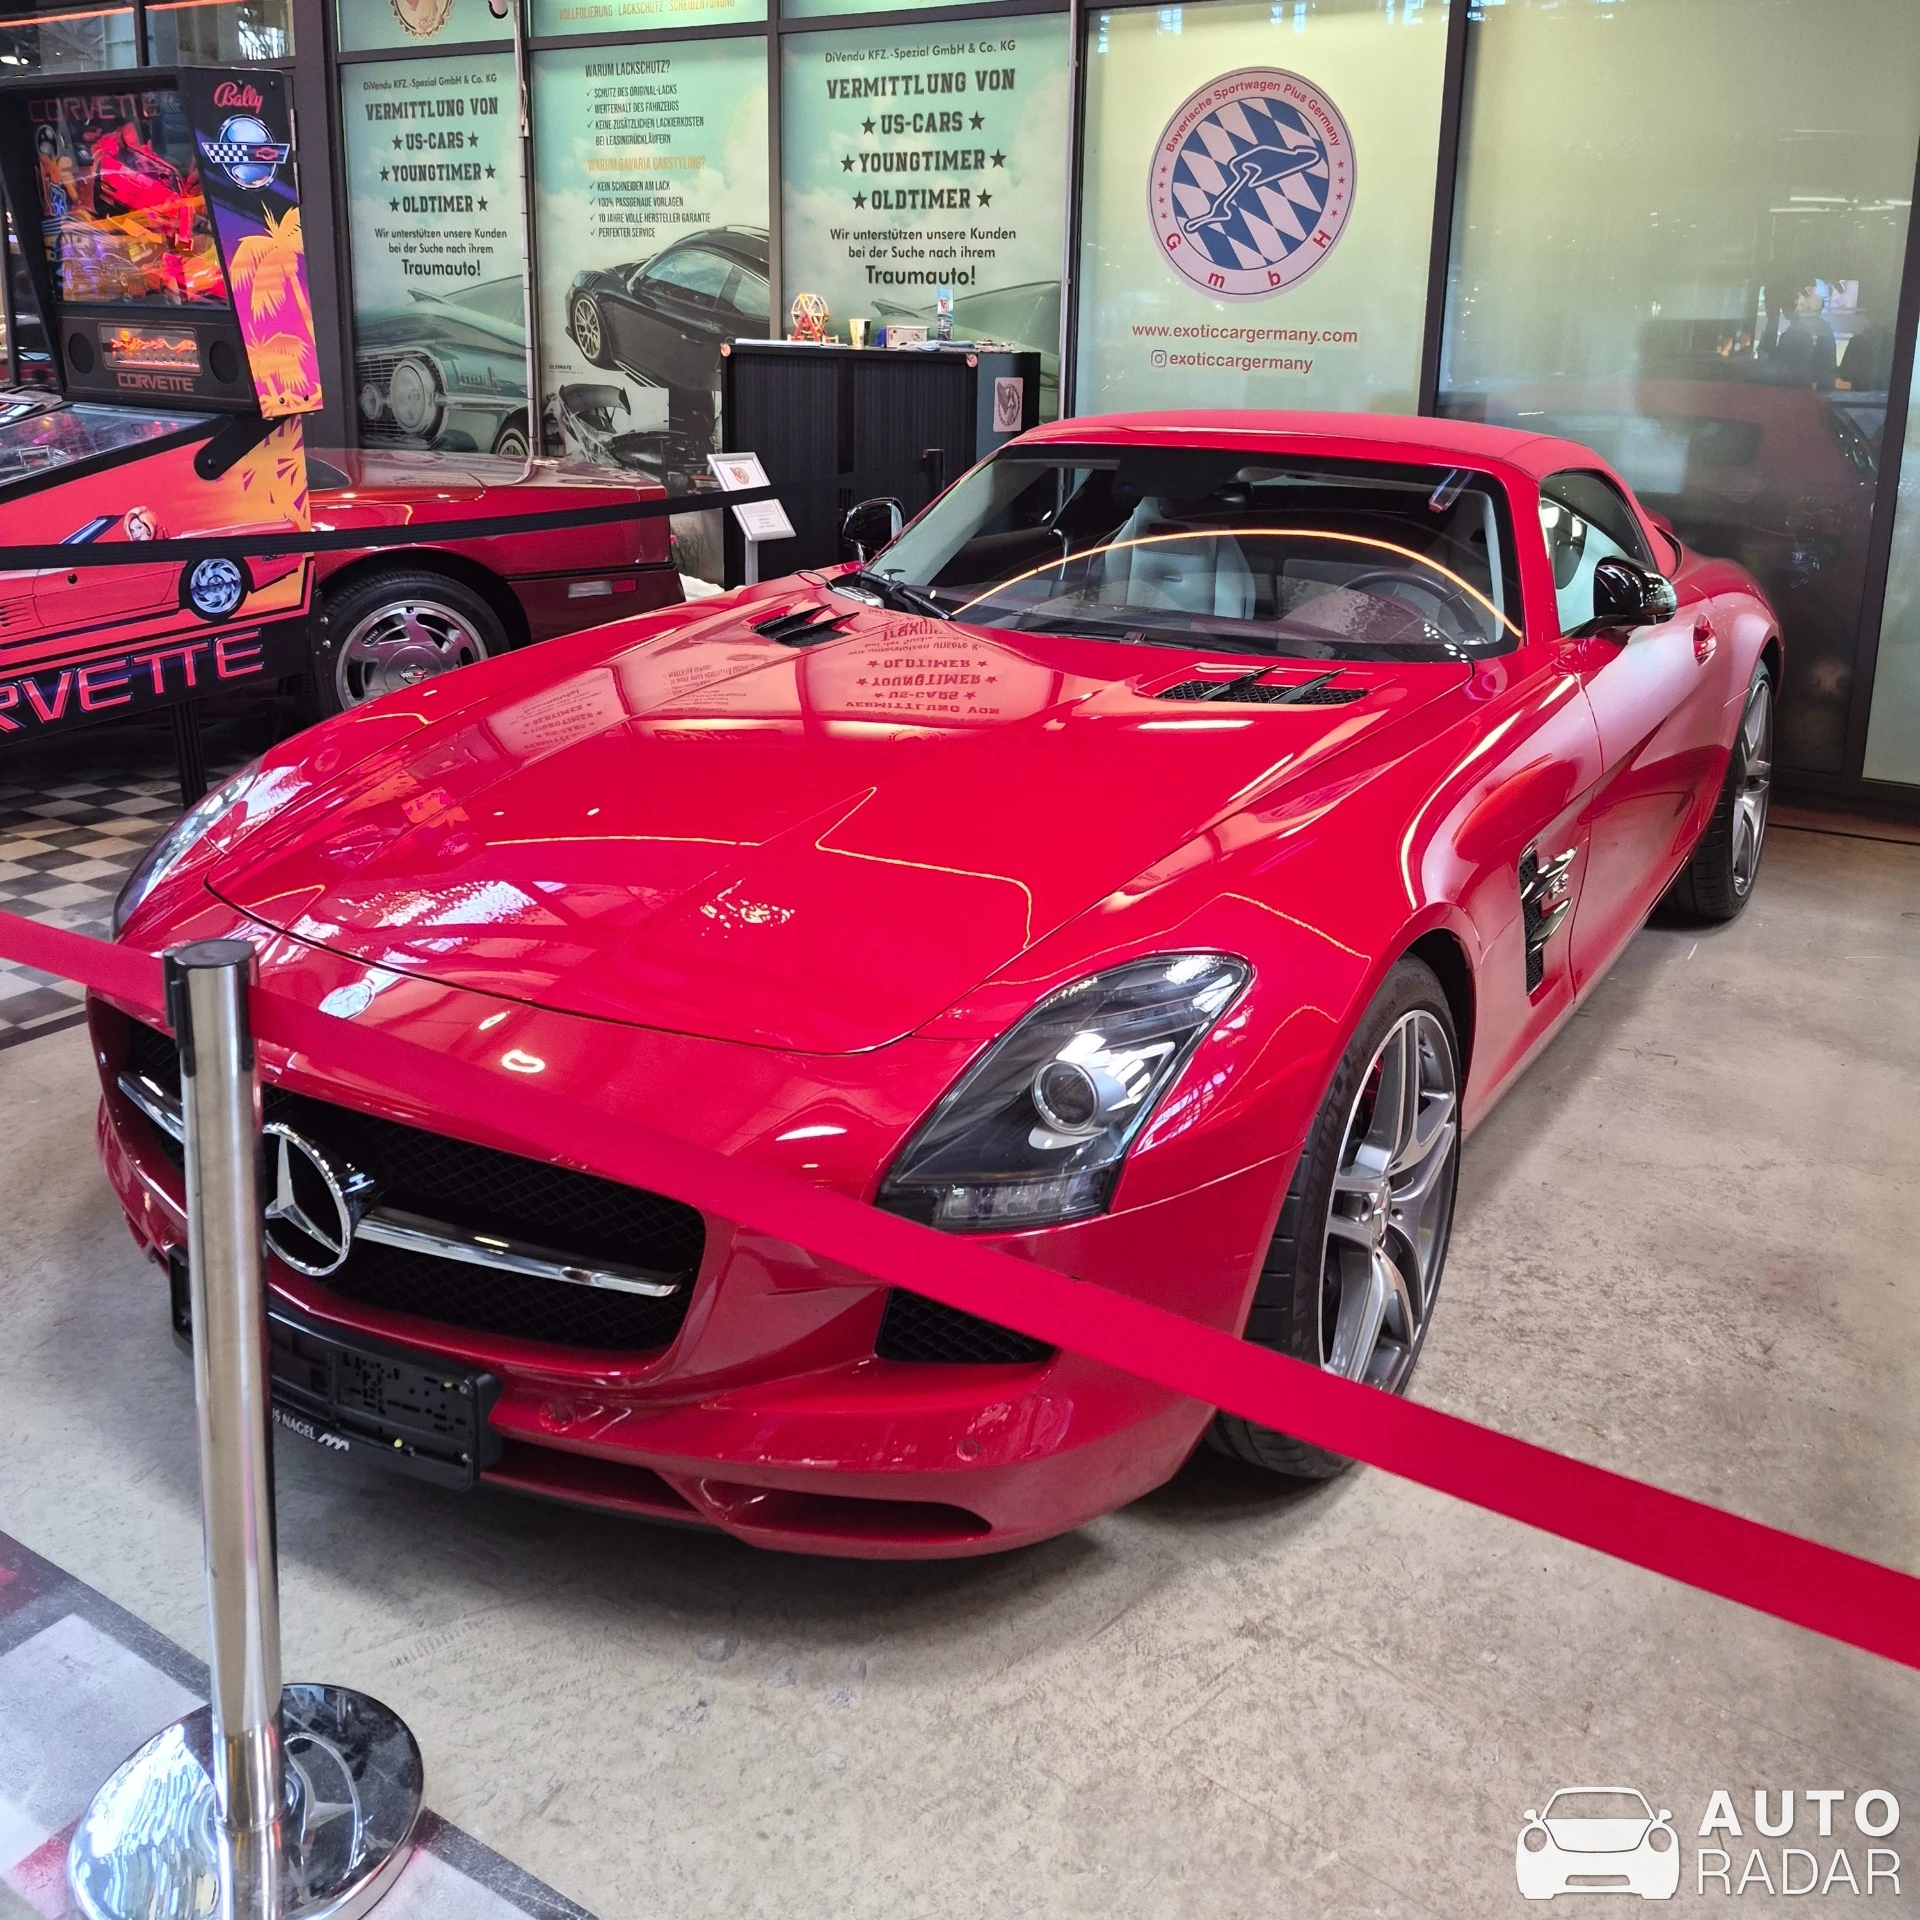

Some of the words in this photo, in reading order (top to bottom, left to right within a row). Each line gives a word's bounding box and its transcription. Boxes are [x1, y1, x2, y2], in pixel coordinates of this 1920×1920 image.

[618, 1, 663, 16] LACKSCHUTZ
[826, 51, 864, 62] DiVendu
[868, 45, 929, 60] KFZ.-Spezial
[933, 44, 964, 56] GmbH
[968, 43, 976, 53] &
[979, 42, 996, 53] Co.
[1000, 40, 1016, 50] KG
[585, 62, 614, 77] WARUM
[616, 60, 670, 76] LACKSCHUTZ?
[364, 80, 392, 90] DiVendu
[394, 77, 436, 89] KFZ.-Spezial
[439, 74, 461, 86] GmbH
[464, 74, 468, 84] &
[472, 74, 484, 84] Co.
[486, 74, 497, 82] KG
[826, 72, 966, 99] VERMITTLUNG
[975, 68, 1016, 91] VON
[213, 82, 263, 114] Bally
[594, 87, 616, 98] SCHUTZ
[618, 87, 628, 97] DES
[630, 84, 677, 96] ORIGINAL-LACKS
[29, 94, 160, 122] CORVETTE
[366, 100, 464, 120] VERMITTLUNG
[470, 97, 498, 115] VON
[594, 104, 631, 114] WERTERHALT
[633, 103, 644, 113] DES
[646, 101, 679, 112] FAHRZEUGS
[596, 120, 612, 130] KEINE
[614, 118, 654, 130] ZUSÄTZLICHEN
[656, 116, 704, 128] LACKIERKOSTEN
[881, 111, 963, 134] US-CARS
[1165, 97, 1212, 153] Bayerische
[1213, 80, 1281, 100] Sportwagen
[1283, 83, 1308, 103] Plus
[1307, 99, 1341, 147] Germany
[406, 132, 464, 150] US-CARS
[596, 136, 604, 146] BEI
[606, 132, 671, 146] LEASINGRÜCKLÄUFERN
[588, 158, 618, 172] WARUM
[619, 157, 650, 170] BAVARIA
[859, 149, 985, 172] YOUNGTIMER
[392, 163, 482, 182] YOUNGTIMER
[597, 182, 610, 191] KEIN
[612, 182, 643, 191] SCHNEIDEN
[644, 181, 654, 190] AM
[656, 181, 670, 190] LACK
[403, 196, 473, 213] OLDTIMER
[598, 198, 614, 207] 100%
[616, 197, 652, 207] PASSGENAUE
[653, 197, 684, 206] VORLAGEN
[872, 188, 970, 210] OLDTIMER
[598, 214, 606, 223] 10
[608, 214, 624, 223] JAHRE
[626, 214, 642, 223] VOLLE
[644, 213, 680, 223] HERSTELLER
[682, 213, 711, 222] GARANTIE
[375, 228, 389, 238] Wir
[392, 228, 440, 238] unterstützen
[444, 230, 472, 238] unsere
[474, 228, 507, 238] Kunden
[598, 228, 630, 238] PERFEKTER
[632, 228, 656, 238] SERVICE
[830, 228, 850, 240] Wir
[853, 229, 922, 240] unterstützen
[926, 231, 966, 240] unsere
[970, 227, 1016, 240] Kunden
[389, 243, 401, 254] bei
[404, 243, 416, 254] der
[420, 244, 444, 254] Suche
[446, 244, 466, 254] nach
[469, 244, 494, 254] ihrem
[848, 246, 865, 258] bei
[869, 246, 888, 258] der
[892, 246, 925, 258] Suche
[928, 246, 956, 258] nach
[960, 246, 996, 258] ihrem
[402, 259, 480, 276] Traumauto!
[866, 265, 976, 286] Traumauto!
[1132, 324, 1358, 344] www.exoticcargermany.com
[1170, 352, 1313, 374] exoticcargermany
[118, 372, 194, 392] CORVETTE
[282, 1414, 316, 1440] NAGEL
